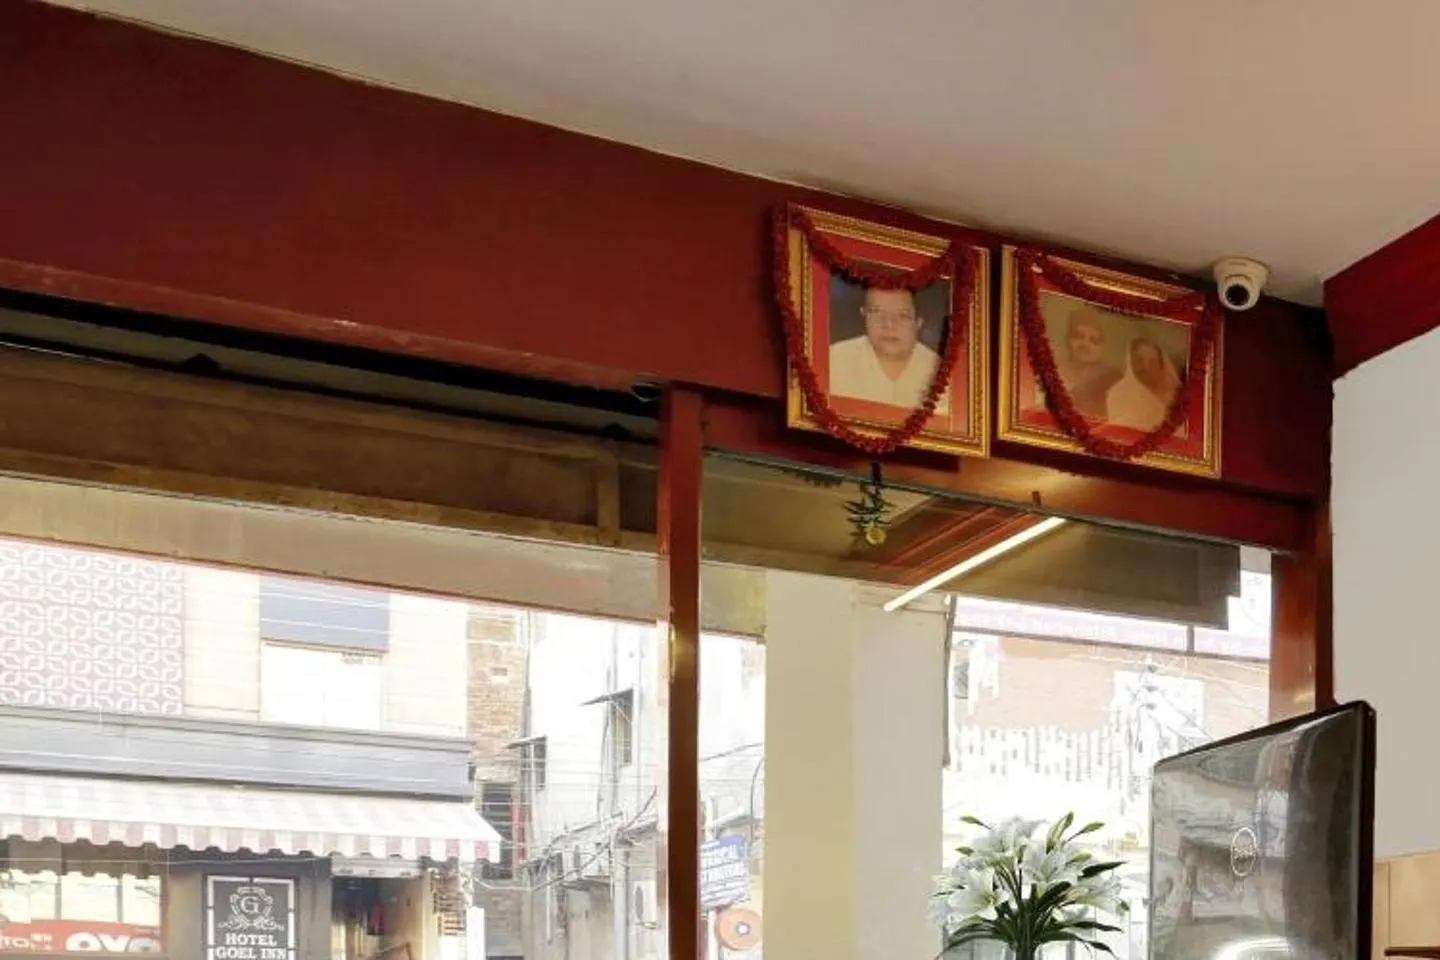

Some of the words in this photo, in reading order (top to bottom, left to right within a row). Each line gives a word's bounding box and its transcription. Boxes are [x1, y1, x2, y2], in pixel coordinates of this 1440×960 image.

[225, 932, 277, 946] HOTEL
[216, 945, 257, 960] GOEL
[260, 947, 287, 960] INN
